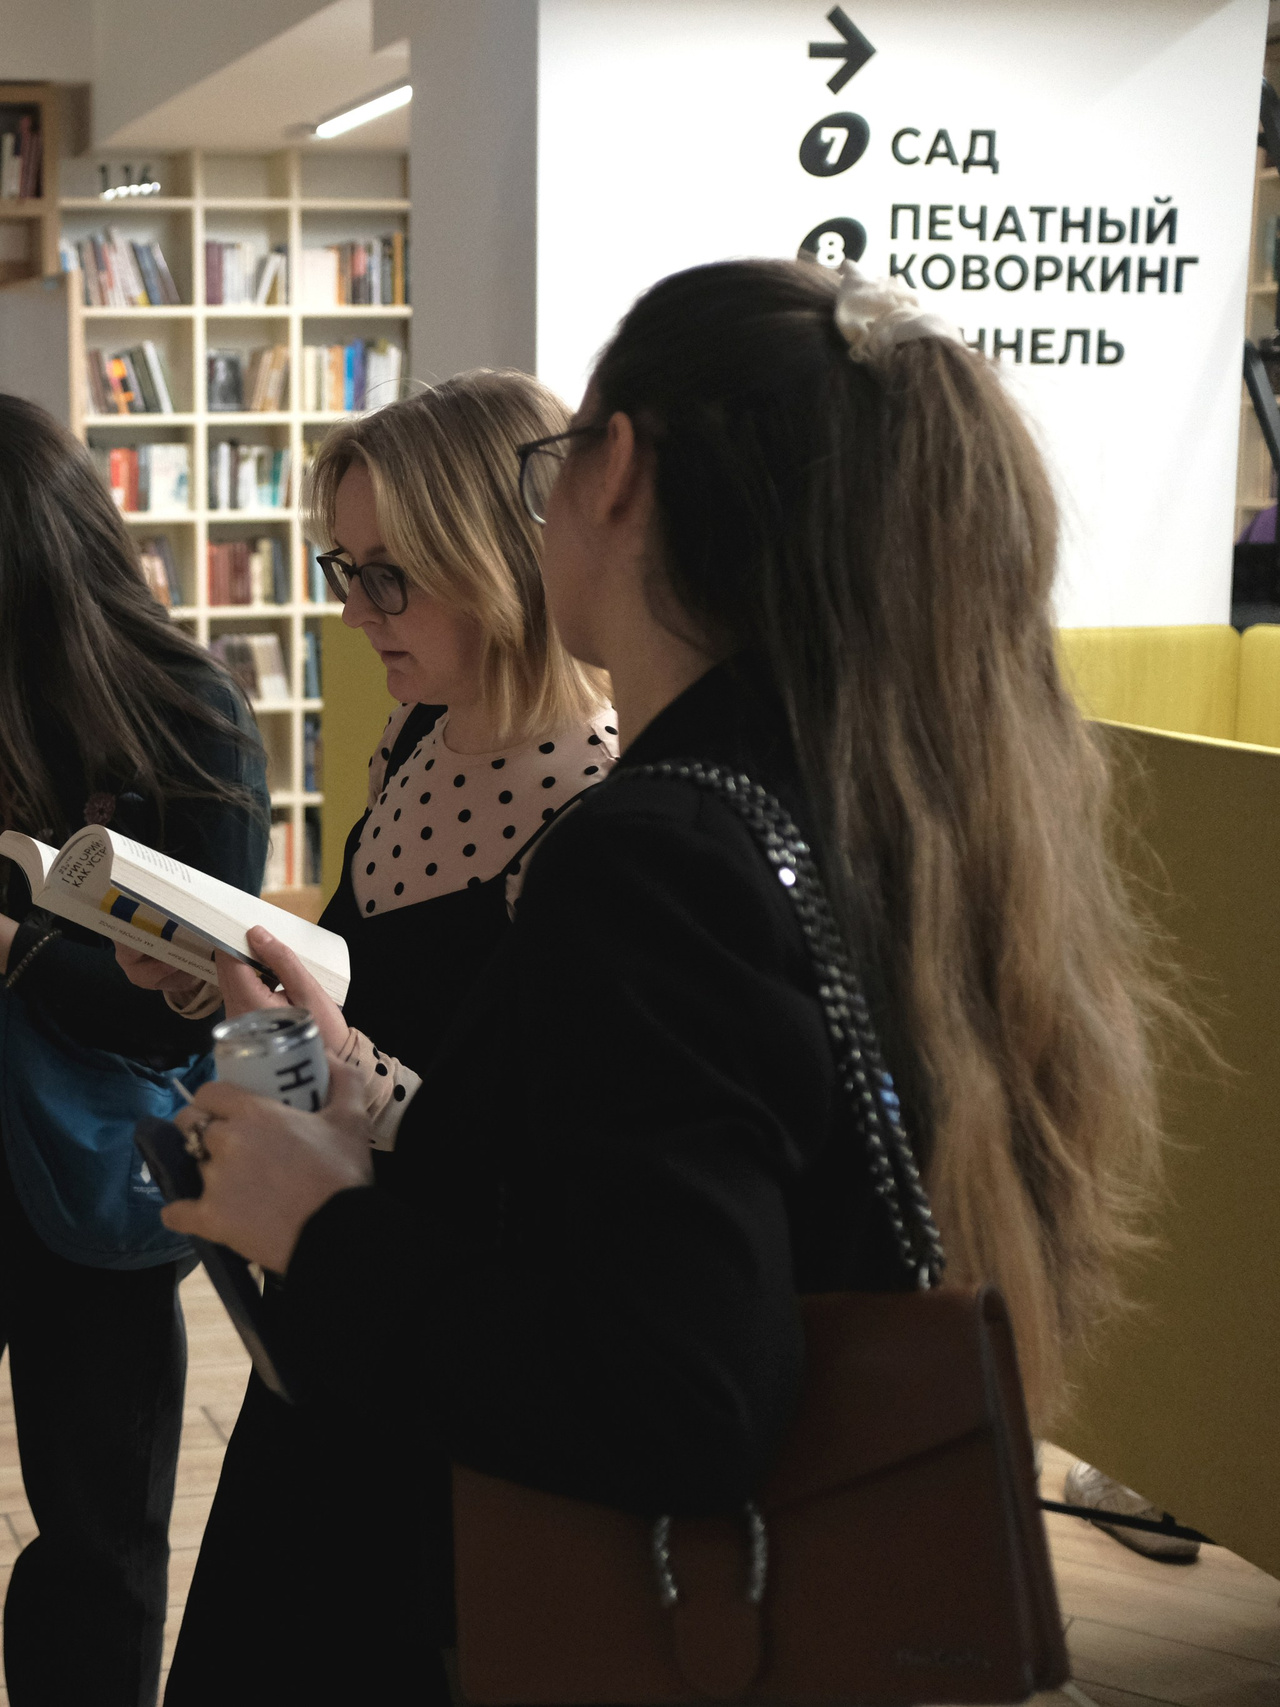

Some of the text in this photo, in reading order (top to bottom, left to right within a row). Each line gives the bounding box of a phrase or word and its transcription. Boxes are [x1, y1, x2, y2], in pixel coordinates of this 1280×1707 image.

[820, 127, 849, 166] 7
[891, 127, 1000, 174] САД
[890, 195, 1178, 245] ПЕЧАТНЫЙ
[816, 231, 846, 268] 8
[889, 253, 1199, 293] КОВОРКИНГ
[72, 868, 91, 888] КАК
